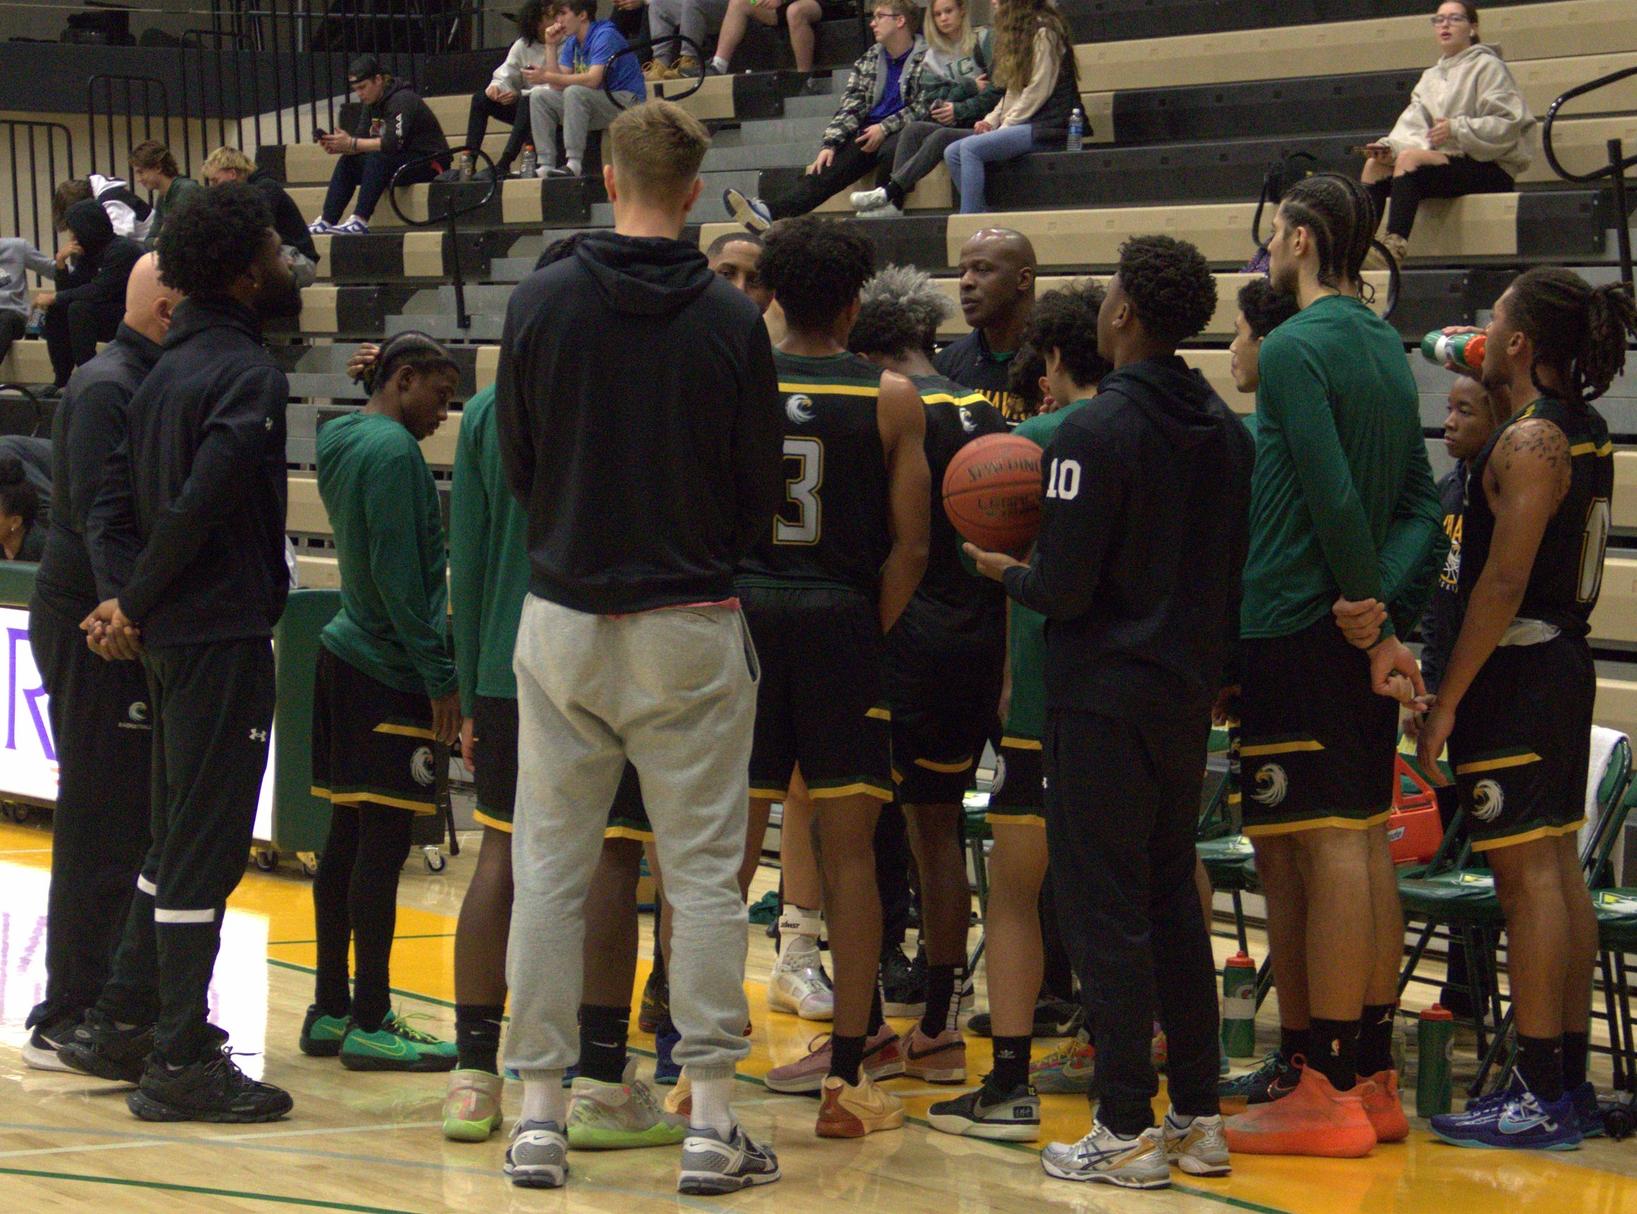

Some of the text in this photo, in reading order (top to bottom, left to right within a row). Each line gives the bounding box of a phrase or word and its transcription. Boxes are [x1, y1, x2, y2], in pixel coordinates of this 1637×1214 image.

[773, 435, 825, 545] 3
[967, 456, 1041, 481] SPALDIN
[1046, 457, 1082, 500] 10
